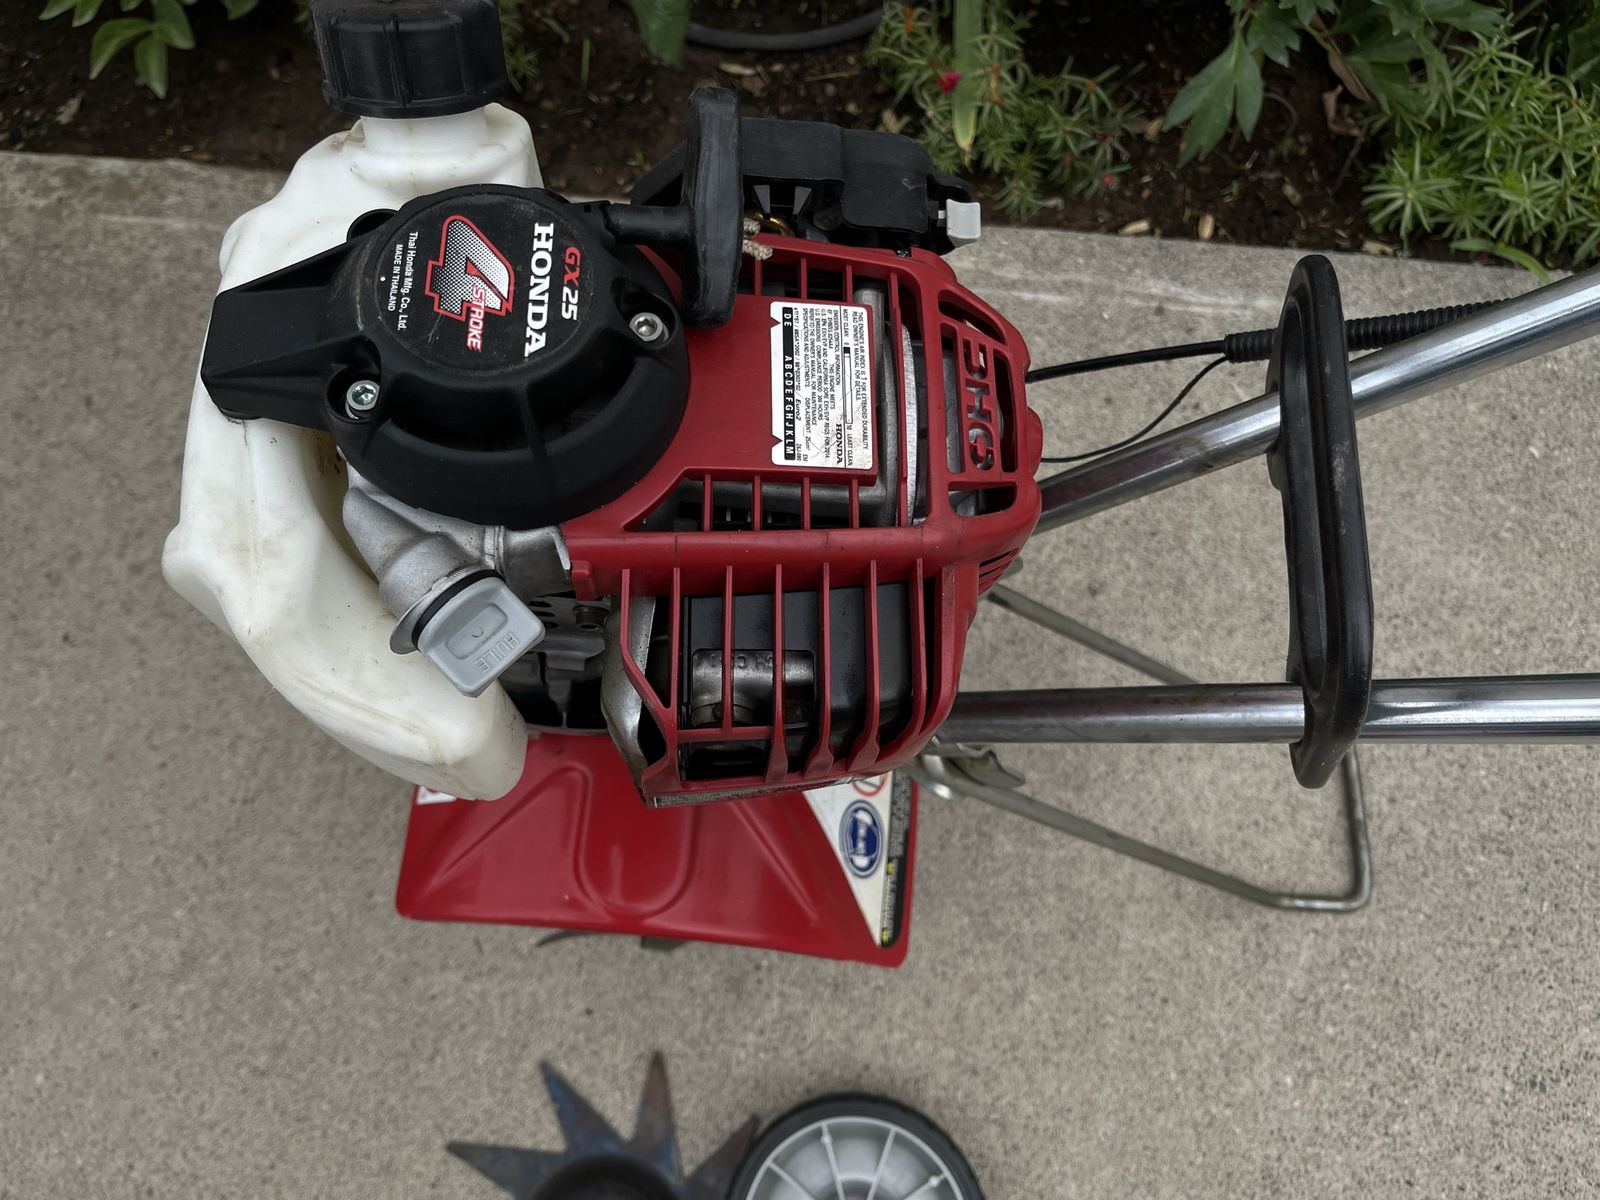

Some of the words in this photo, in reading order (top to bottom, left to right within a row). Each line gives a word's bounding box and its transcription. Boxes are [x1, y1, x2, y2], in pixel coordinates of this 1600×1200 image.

[393, 244, 402, 264] MADE
[408, 232, 419, 248] Thai
[404, 251, 416, 276] Honda
[425, 215, 514, 322] 4
[387, 275, 399, 311] THAILAND
[401, 278, 413, 295] Mfg.
[524, 223, 554, 357] HONDA
[561, 246, 581, 320] GX25
[399, 297, 410, 313] Co.,
[467, 286, 485, 352] STROKE
[398, 314, 409, 331] Ltd.
[474, 632, 520, 673] HUILE
